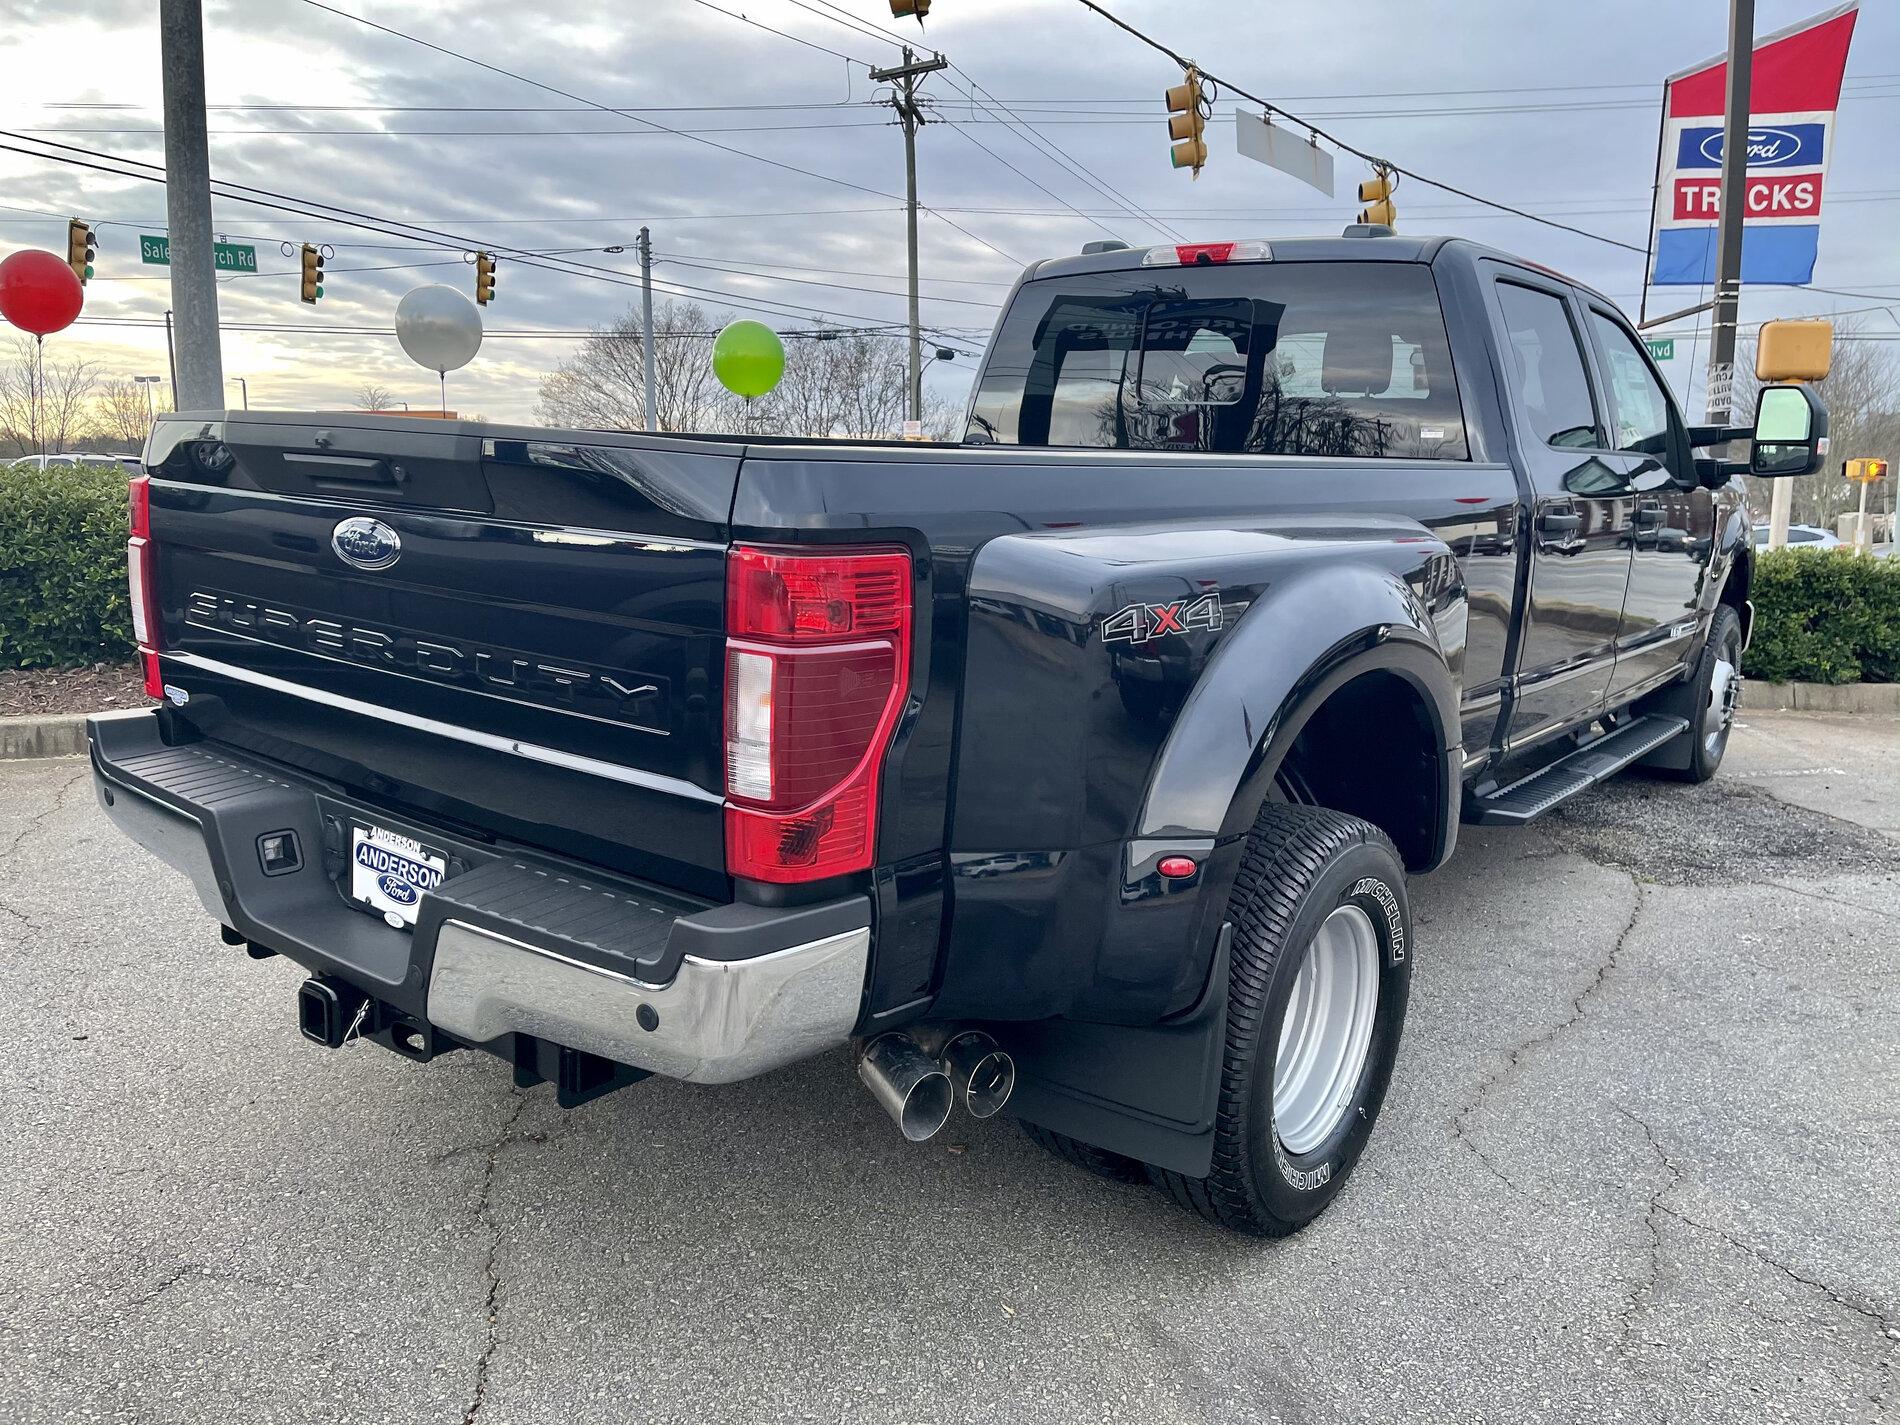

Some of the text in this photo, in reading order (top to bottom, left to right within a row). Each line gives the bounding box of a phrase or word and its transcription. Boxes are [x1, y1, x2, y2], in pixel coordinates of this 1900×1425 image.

[1680, 182, 1814, 212] TRCKS
[143, 241, 254, 267] Sale rch Rd
[185, 592, 658, 717] SUPER DUTY
[370, 826, 421, 854] ANDERSON
[358, 845, 441, 890] ANDERSON
[383, 876, 410, 902] Ford
[1350, 878, 1405, 961] MICHELIN
